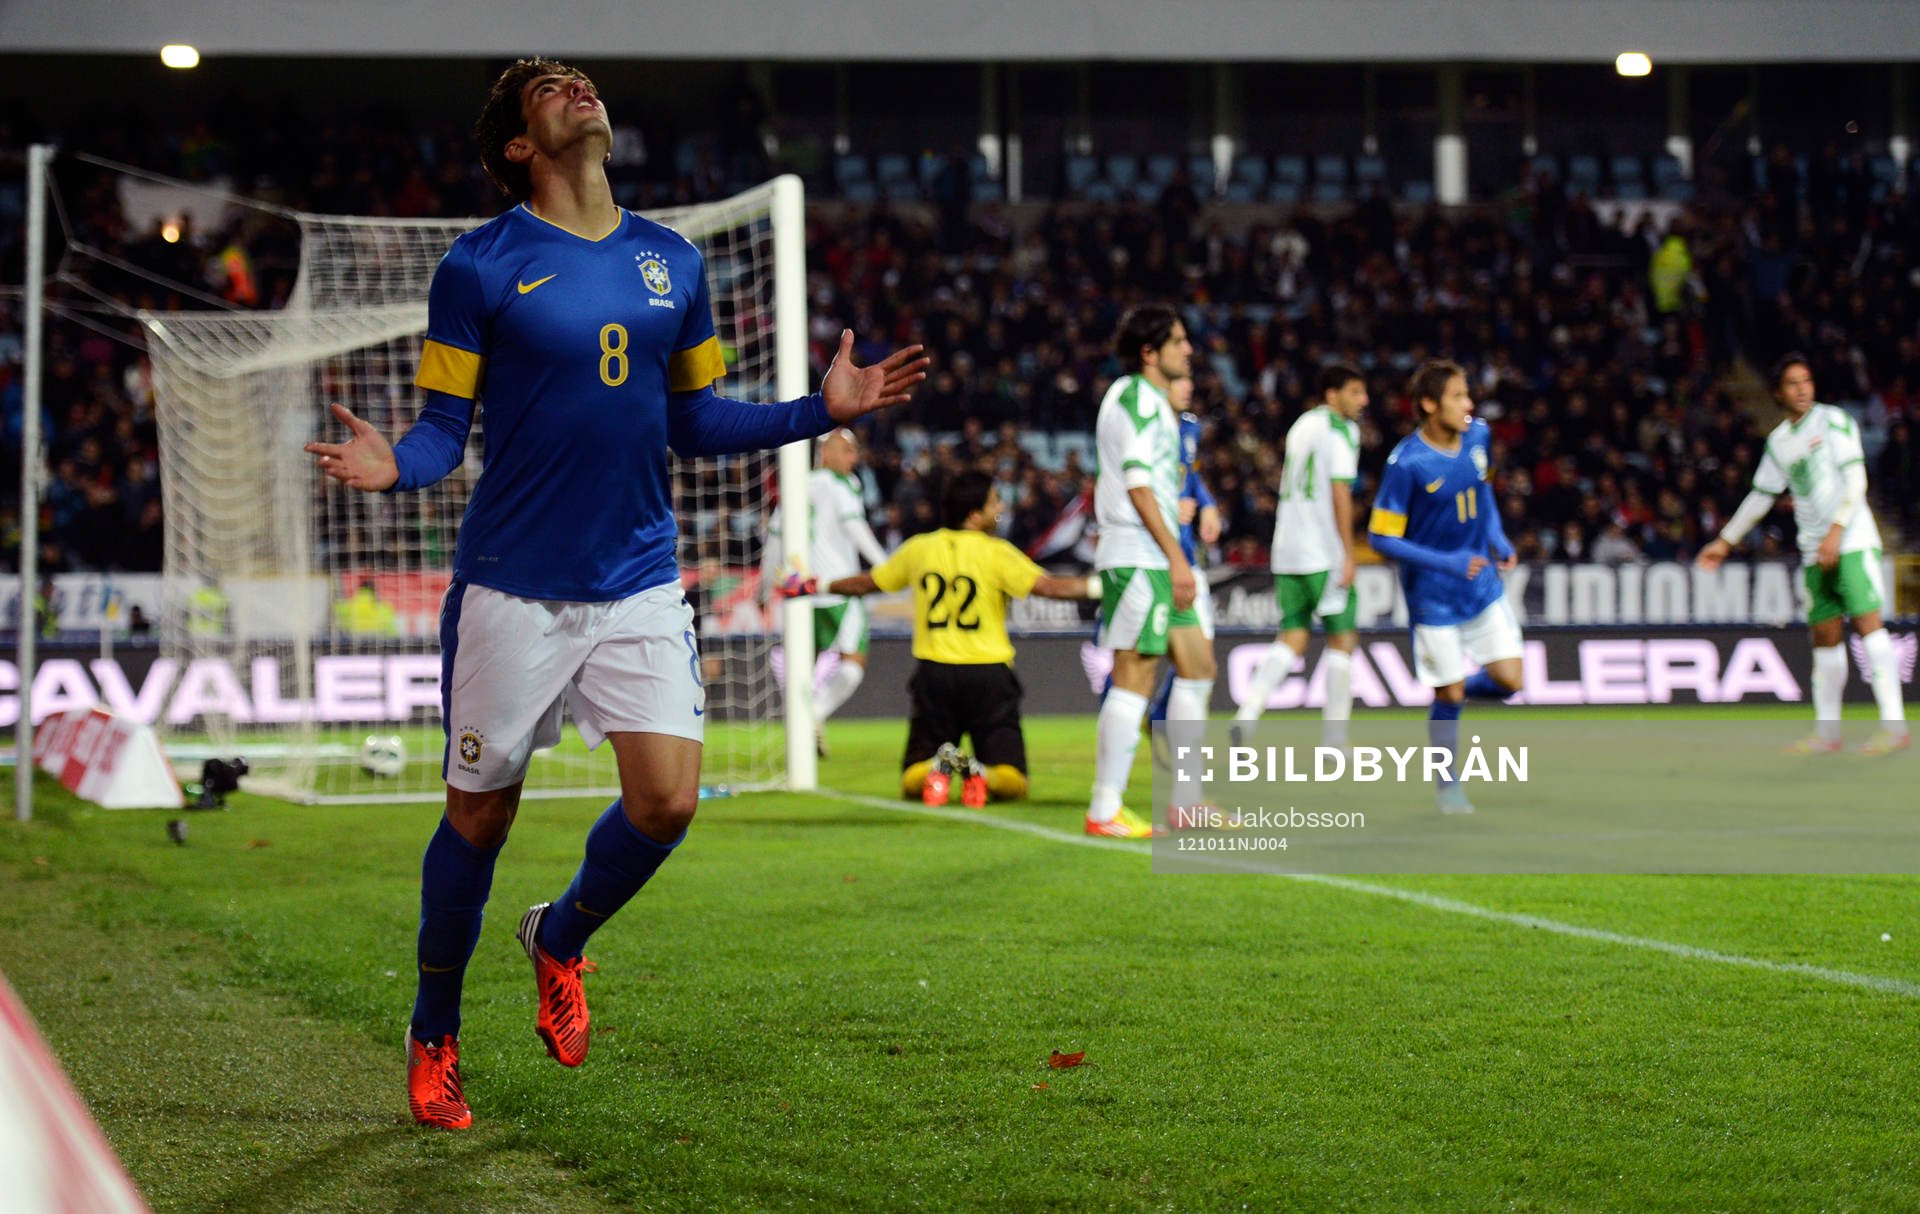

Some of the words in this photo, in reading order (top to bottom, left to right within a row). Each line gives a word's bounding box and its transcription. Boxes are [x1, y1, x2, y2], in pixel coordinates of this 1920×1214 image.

[648, 298, 675, 310] BRASIL
[599, 323, 629, 387] 8
[1456, 486, 1477, 524] 11
[922, 572, 980, 632] 22
[1152, 602, 1169, 636] 6
[1544, 561, 1808, 627] IDIOMA
[0, 656, 443, 727] AVALER
[1227, 637, 1803, 709] CAVLERA
[458, 763, 480, 776] BRASIL
